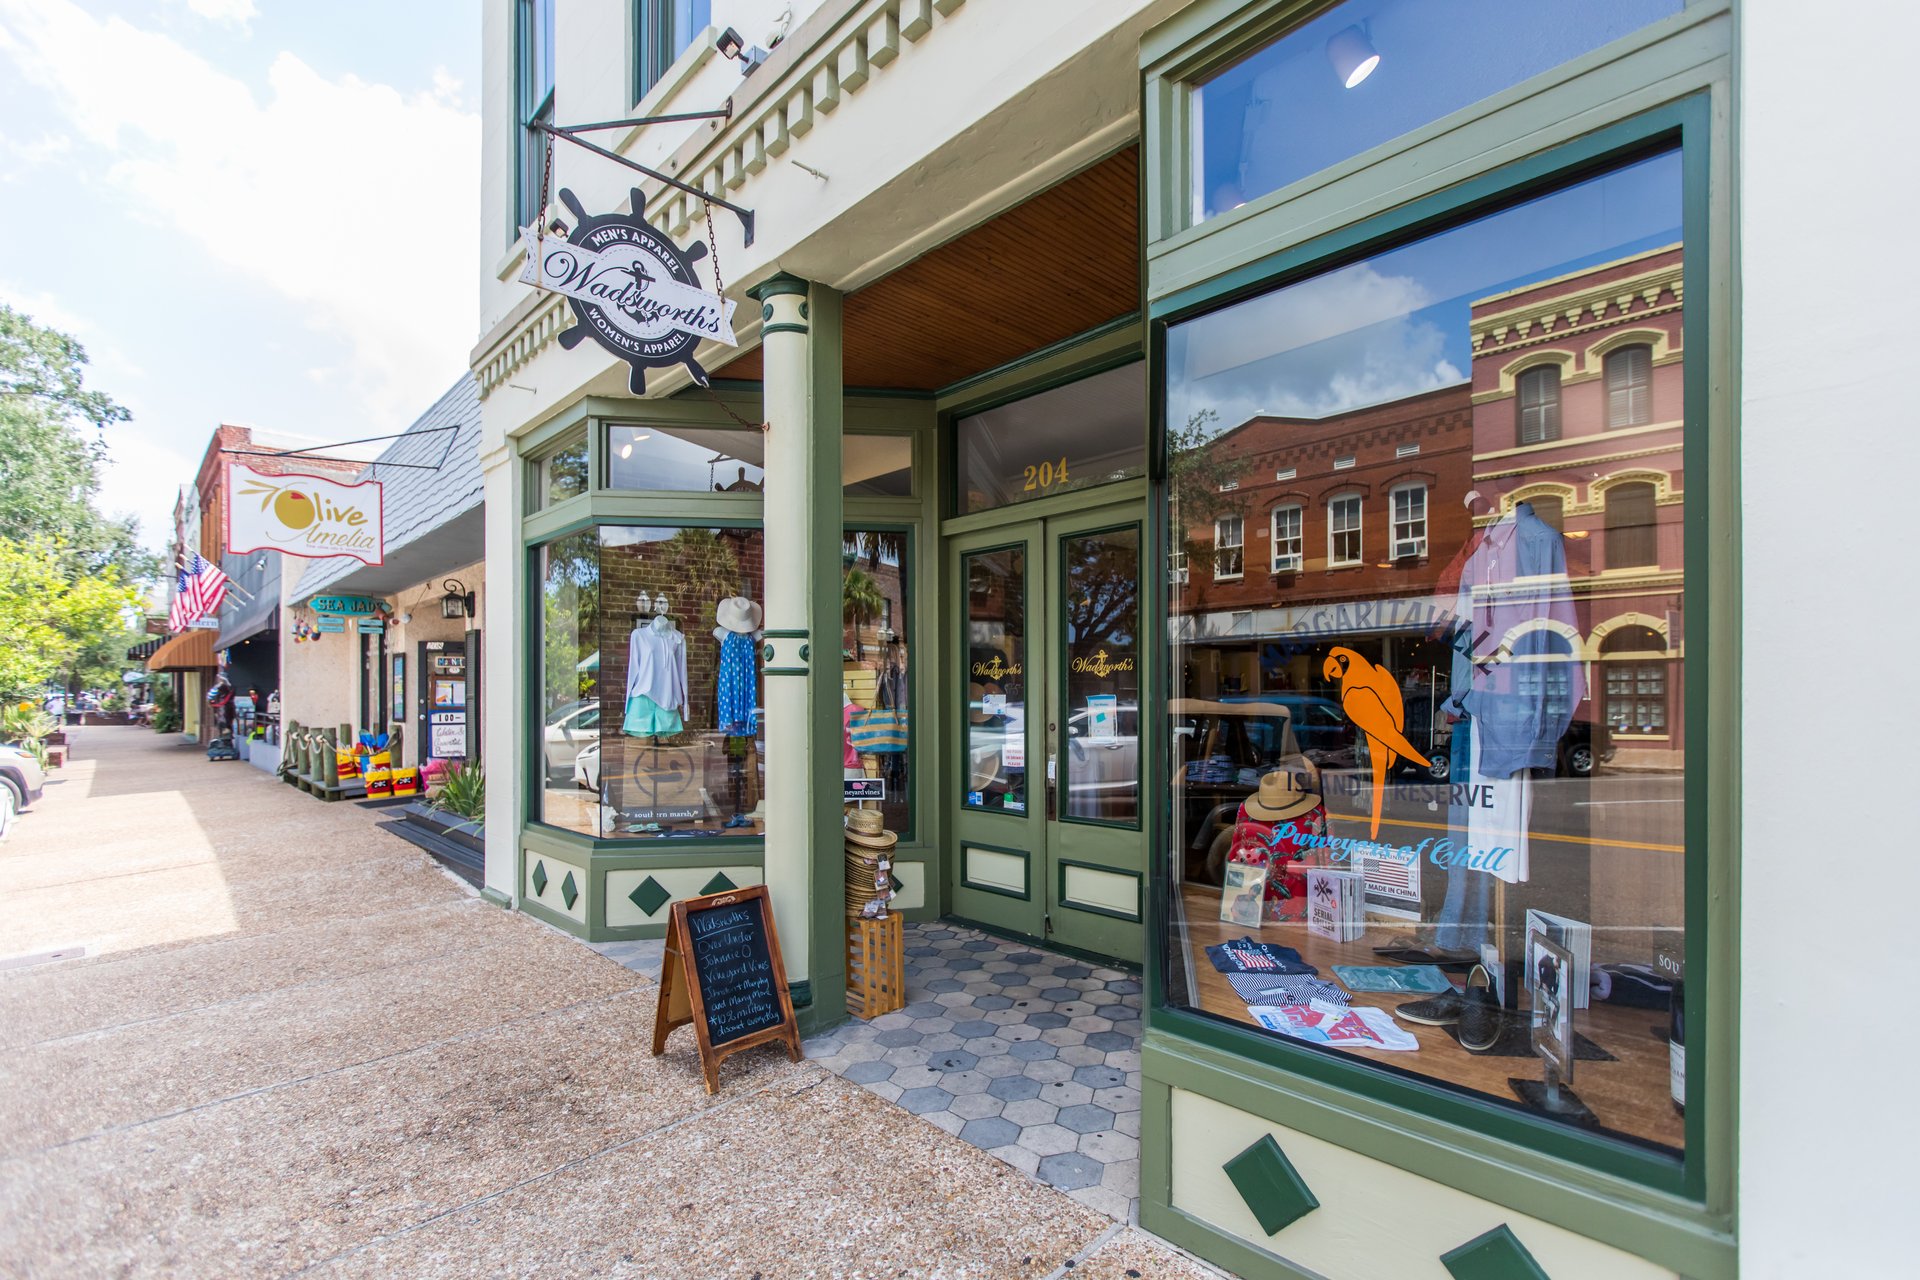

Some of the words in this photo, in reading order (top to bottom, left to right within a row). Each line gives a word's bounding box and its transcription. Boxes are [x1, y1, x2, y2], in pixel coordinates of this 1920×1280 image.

[591, 228, 628, 247] MEN'S
[632, 232, 680, 274] APPAREL
[544, 250, 720, 333] Wadsworth's
[588, 308, 639, 352] WOMEN'S
[644, 333, 686, 354] APPAREL
[1023, 457, 1069, 491] 204
[304, 522, 376, 549] Amelia
[318, 599, 345, 611] SEA
[1260, 599, 1514, 676] MARGARITAVILLE
[972, 661, 1022, 677] Wadsworth's
[1071, 657, 1134, 674] Wadsworth's
[1287, 772, 1361, 797] ISLAND
[1394, 783, 1494, 808] RESERVE
[1269, 820, 1393, 863] Purveyors
[1397, 837, 1434, 866] of
[1429, 837, 1515, 872] Chill
[1368, 884, 1387, 892] MADE
[1396, 889, 1417, 897] CHINA
[724, 931, 754, 944] Under
[701, 951, 740, 969] Johnnie
[742, 944, 751, 958] O
[1658, 953, 1685, 974] SOU
[712, 1000, 726, 1011] and
